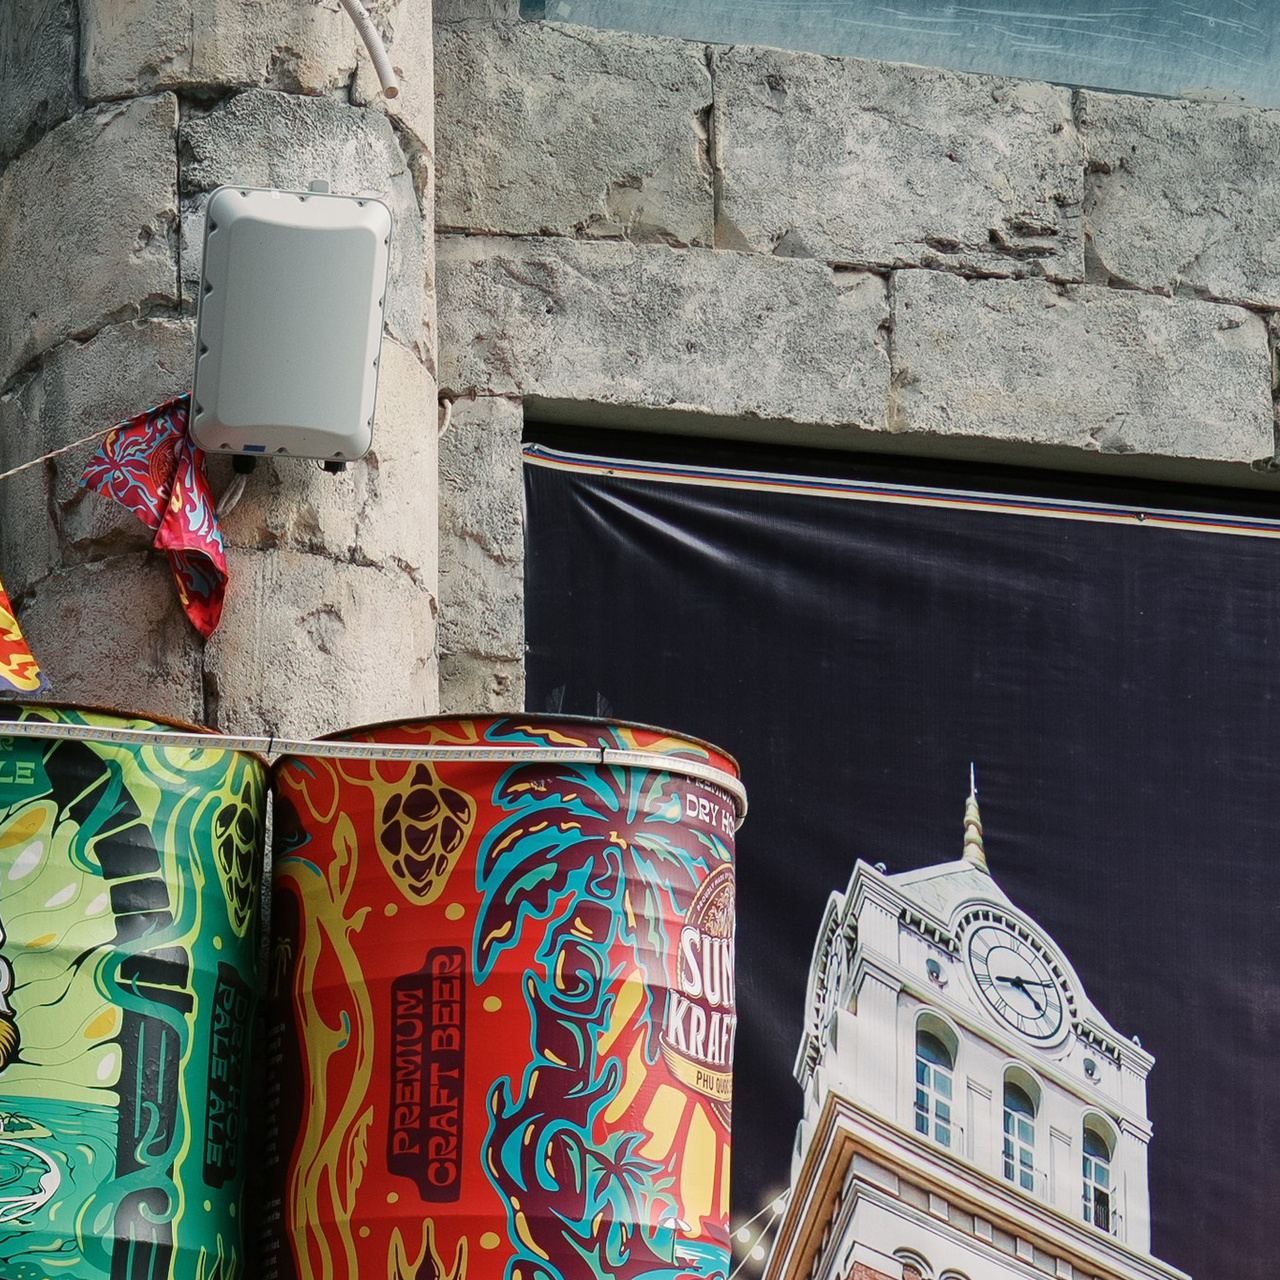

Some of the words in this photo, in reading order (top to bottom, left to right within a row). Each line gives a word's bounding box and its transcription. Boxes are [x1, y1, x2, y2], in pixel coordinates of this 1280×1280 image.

[686, 793, 719, 827] DRY
[431, 954, 462, 1052] BEER
[681, 925, 734, 1008] SUN
[211, 982, 236, 1081] PALE
[393, 989, 423, 1156] PREMIUM
[427, 1062, 460, 1187] CRAFT
[696, 1070, 714, 1091] PHU
[206, 1089, 227, 1167] ALE
